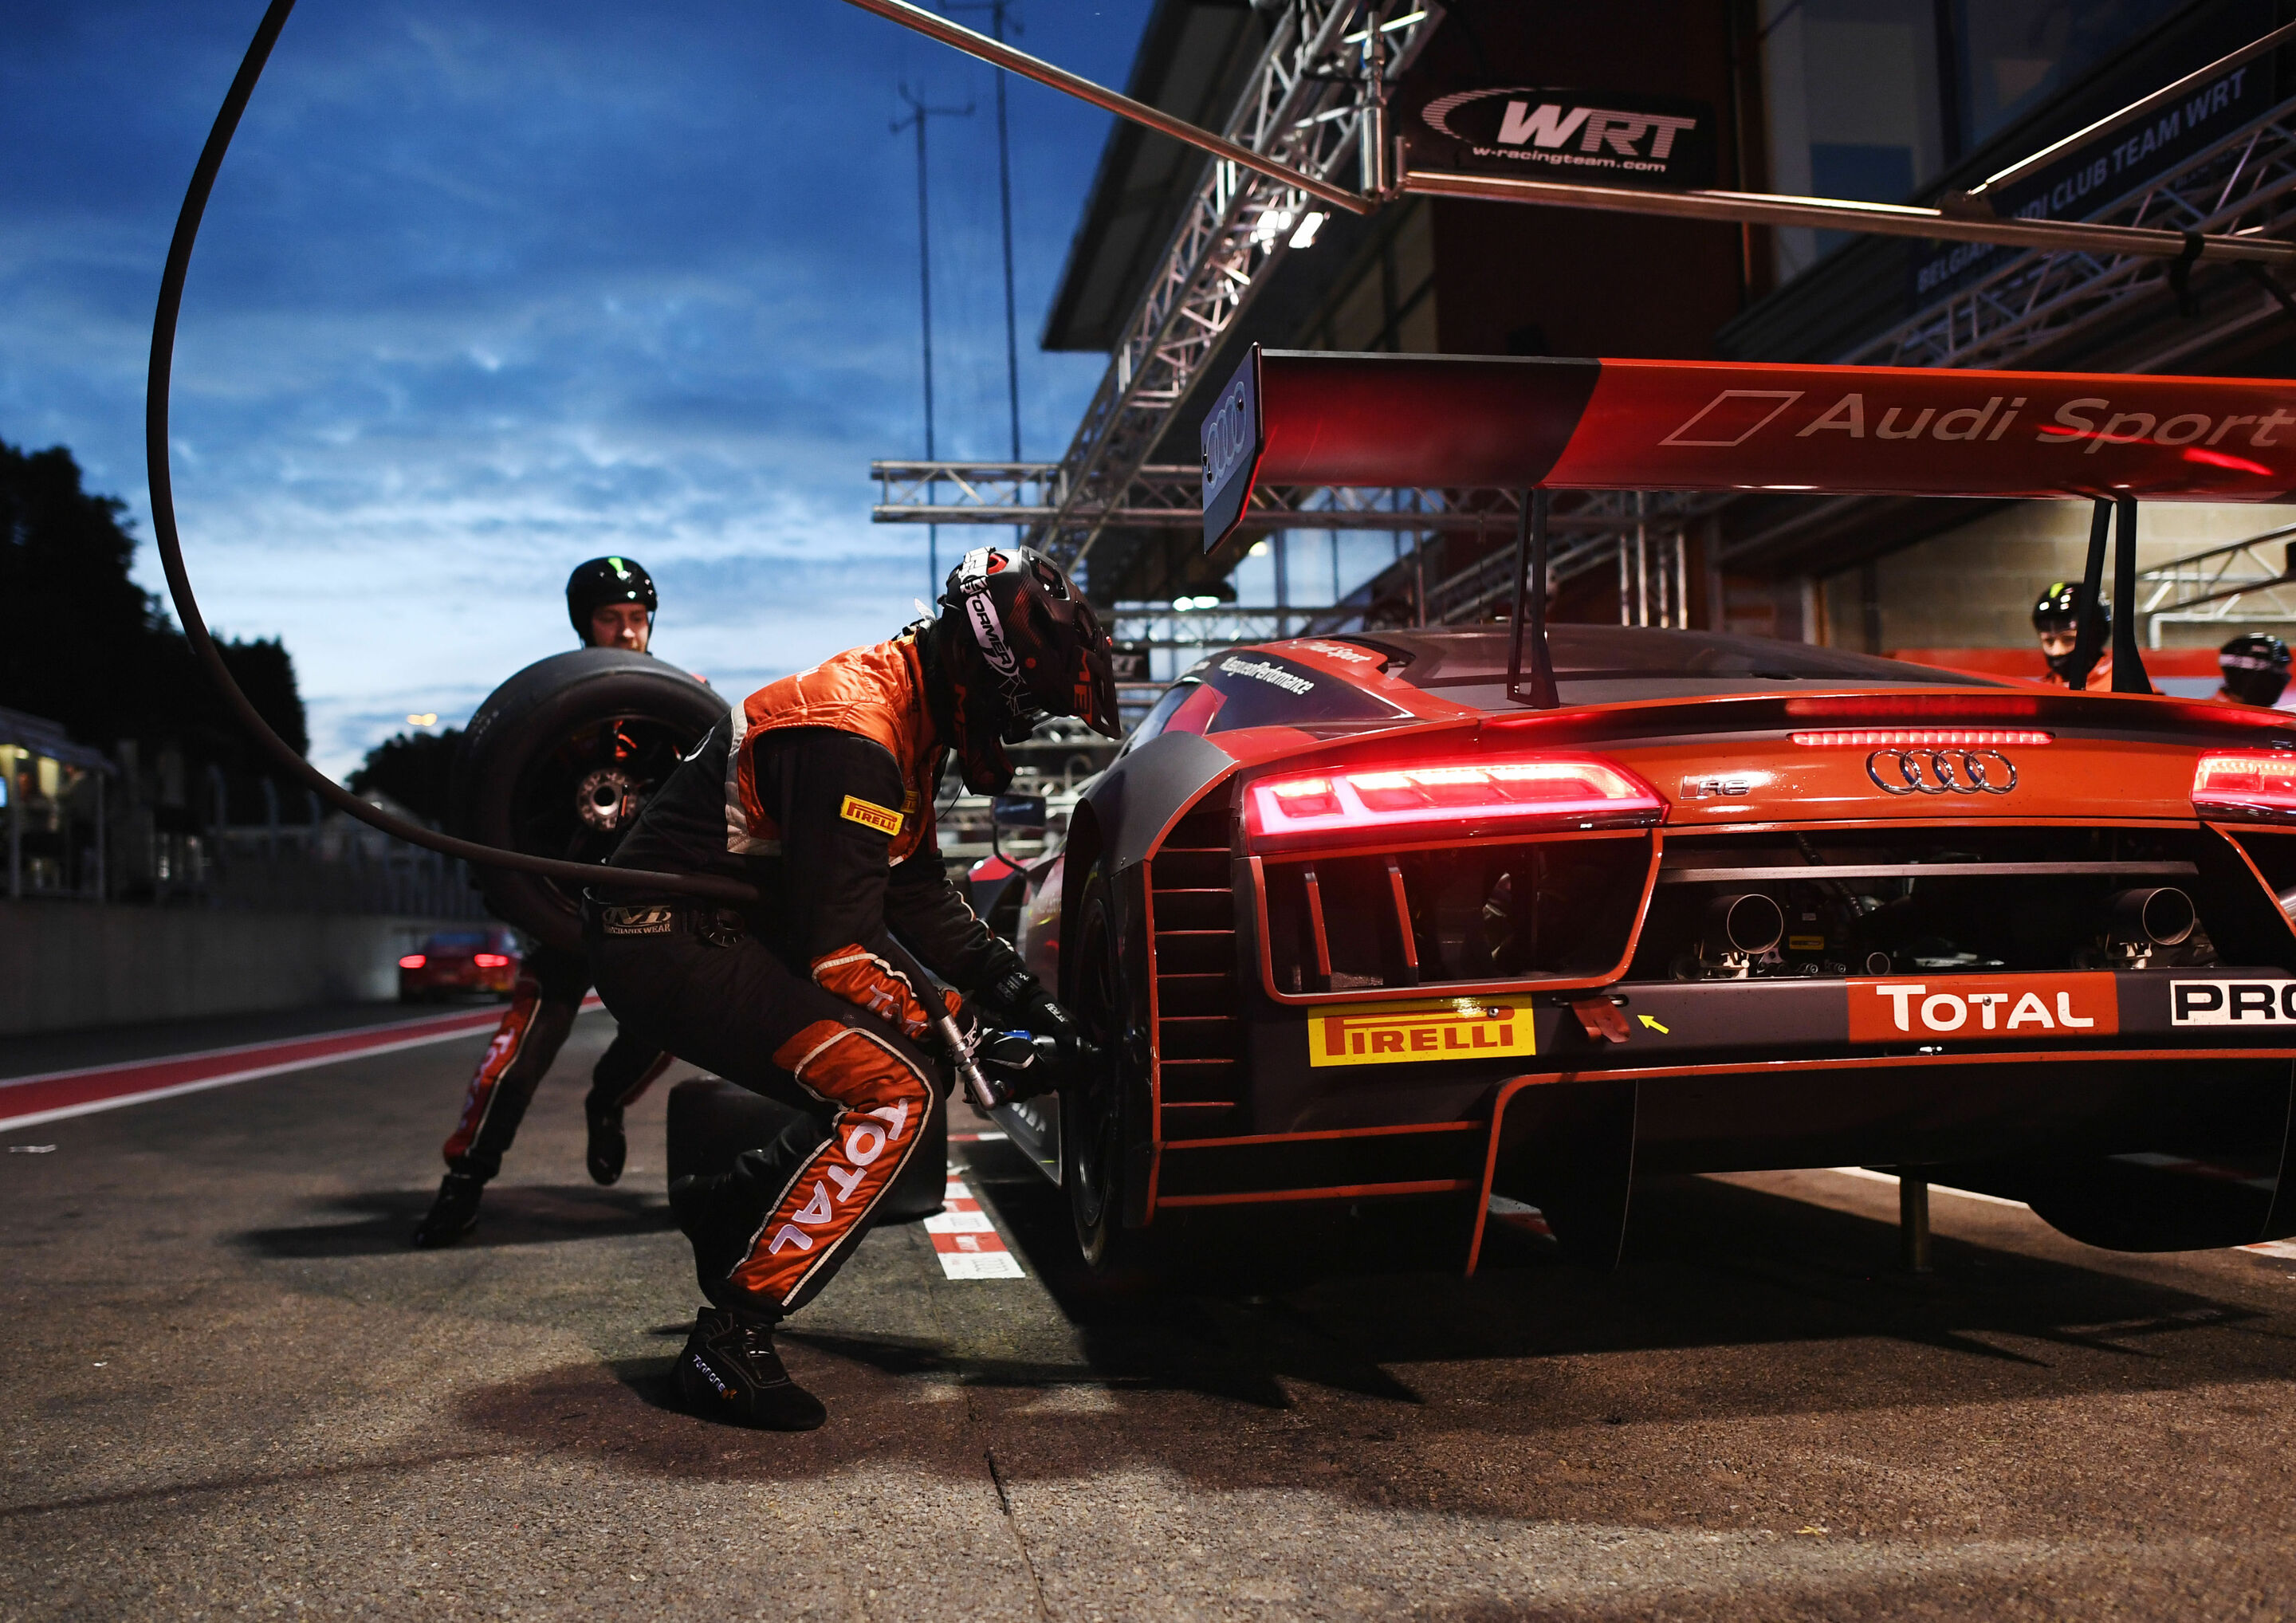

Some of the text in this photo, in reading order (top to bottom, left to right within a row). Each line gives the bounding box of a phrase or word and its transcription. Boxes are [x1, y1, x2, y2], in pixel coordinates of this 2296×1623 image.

[1496, 100, 1697, 159] WRT
[2051, 156, 2107, 211] CLUB
[2112, 109, 2181, 173] TEAM
[2185, 66, 2247, 128] WRT
[1472, 146, 1667, 173] w-racingteam.com
[1795, 393, 2296, 454] Audi Sport
[846, 801, 898, 831] PIRELLI
[643, 923, 671, 933] WEAR
[1324, 1005, 1515, 1056] PIRELLI
[1876, 984, 2094, 1032] TOTAL
[769, 1097, 911, 1256] TOTAL
